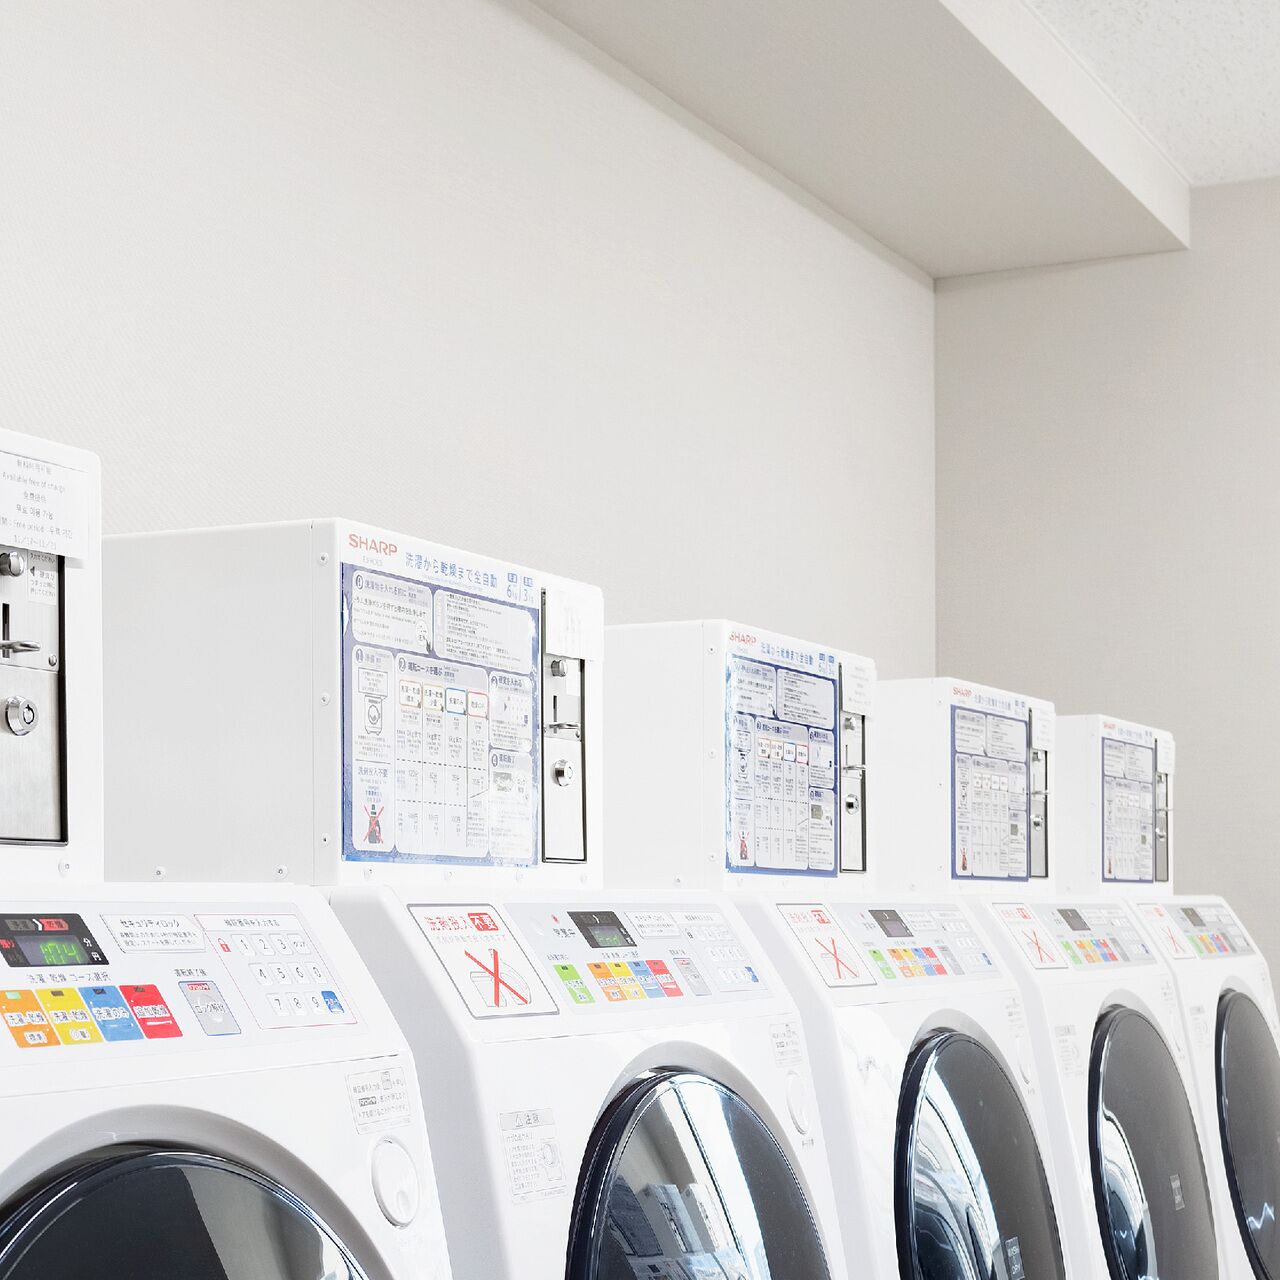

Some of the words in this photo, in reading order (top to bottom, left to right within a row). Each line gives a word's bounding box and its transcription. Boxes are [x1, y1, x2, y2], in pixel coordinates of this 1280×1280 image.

[348, 533, 398, 556] SHARP
[405, 551, 498, 588] 洗濯から乾燥まで全自動
[729, 631, 757, 645] SHARP
[120, 919, 180, 928] セキュリティロック
[83, 938, 93, 947] 分
[240, 939, 248, 950] 1
[259, 938, 269, 950] 2
[277, 938, 287, 950] 3
[91, 951, 102, 961] 円
[258, 968, 267, 980] 4
[276, 967, 286, 979] 5
[295, 966, 304, 978] 6
[312, 966, 322, 978] 0
[194, 1003, 226, 1014] ロック解除
[274, 998, 282, 1010] 7
[293, 997, 302, 1009] 8
[311, 996, 320, 1008] 9
[95, 1007, 129, 1020] 洗濯のみ
